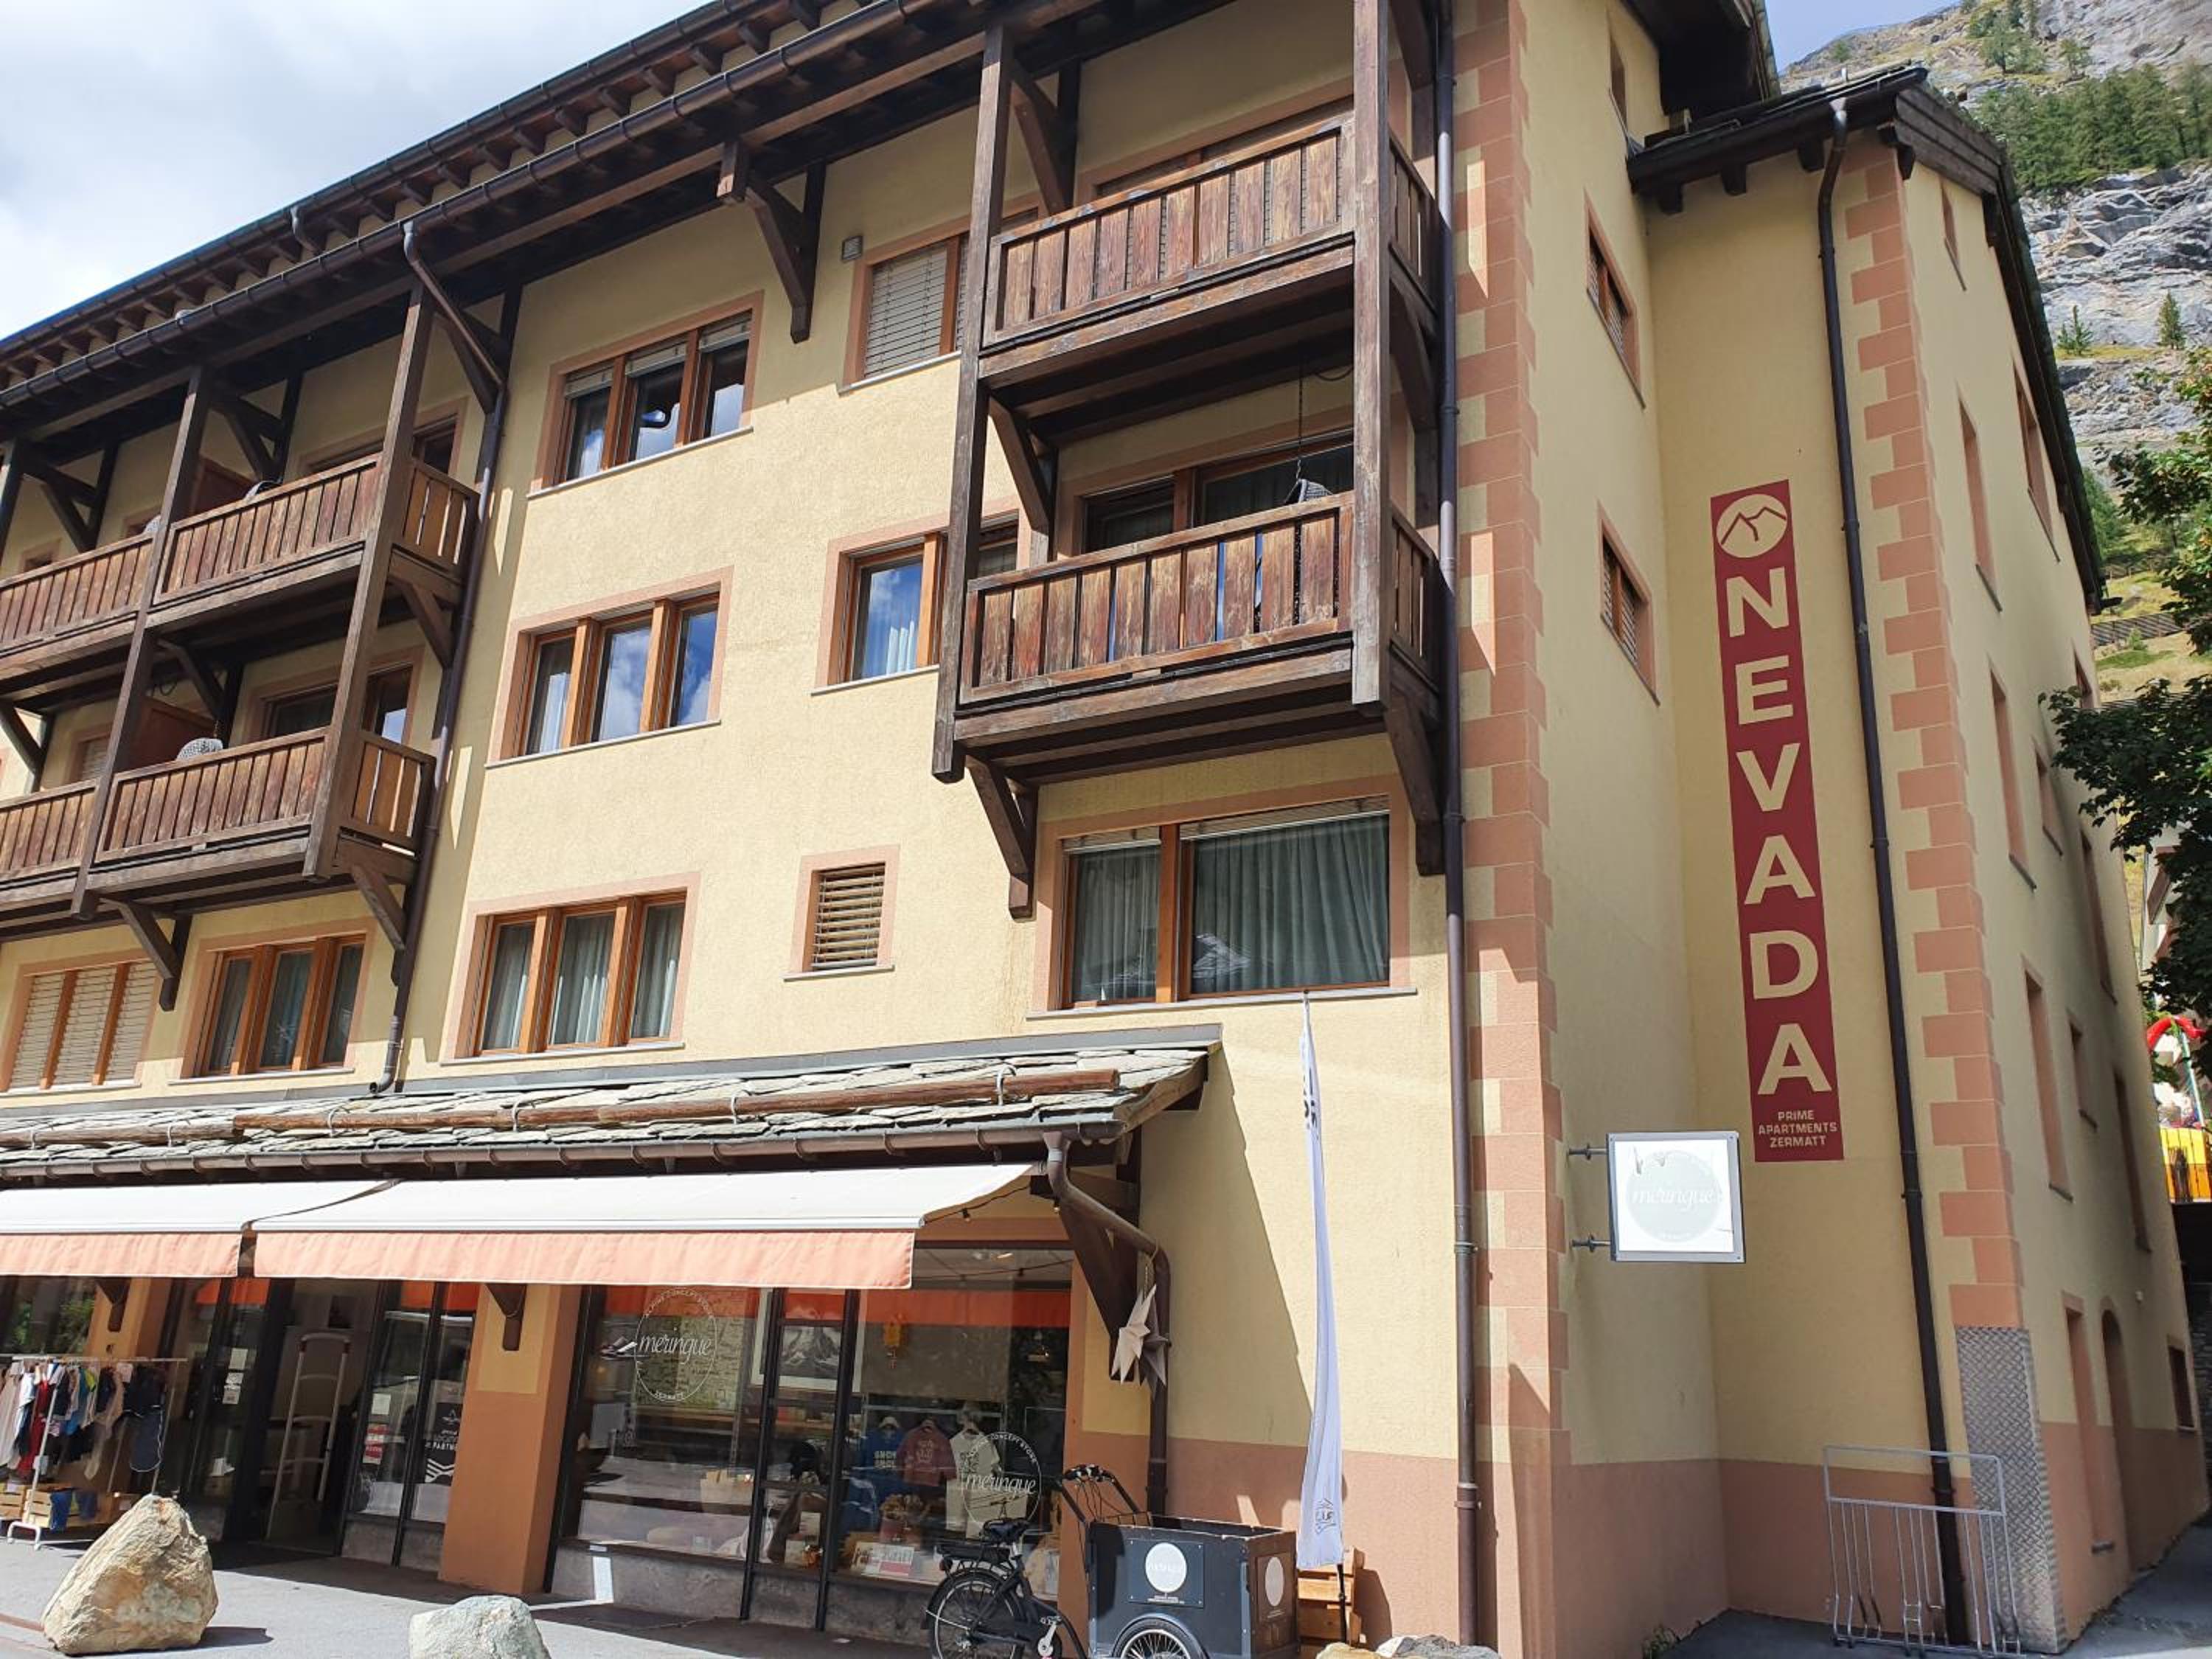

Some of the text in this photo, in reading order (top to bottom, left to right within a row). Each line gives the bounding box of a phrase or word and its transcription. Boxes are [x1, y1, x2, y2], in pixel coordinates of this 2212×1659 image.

[1724, 566, 1832, 1096] NEVADA
[1777, 1110, 1815, 1121] PRIME
[1758, 1121, 1838, 1135] APARTMENTS
[1769, 1135, 1826, 1148] ZERMATT
[1631, 1189, 1713, 1213] meringue
[639, 1333, 712, 1366] meringue
[965, 1473, 1037, 1500] meringue
